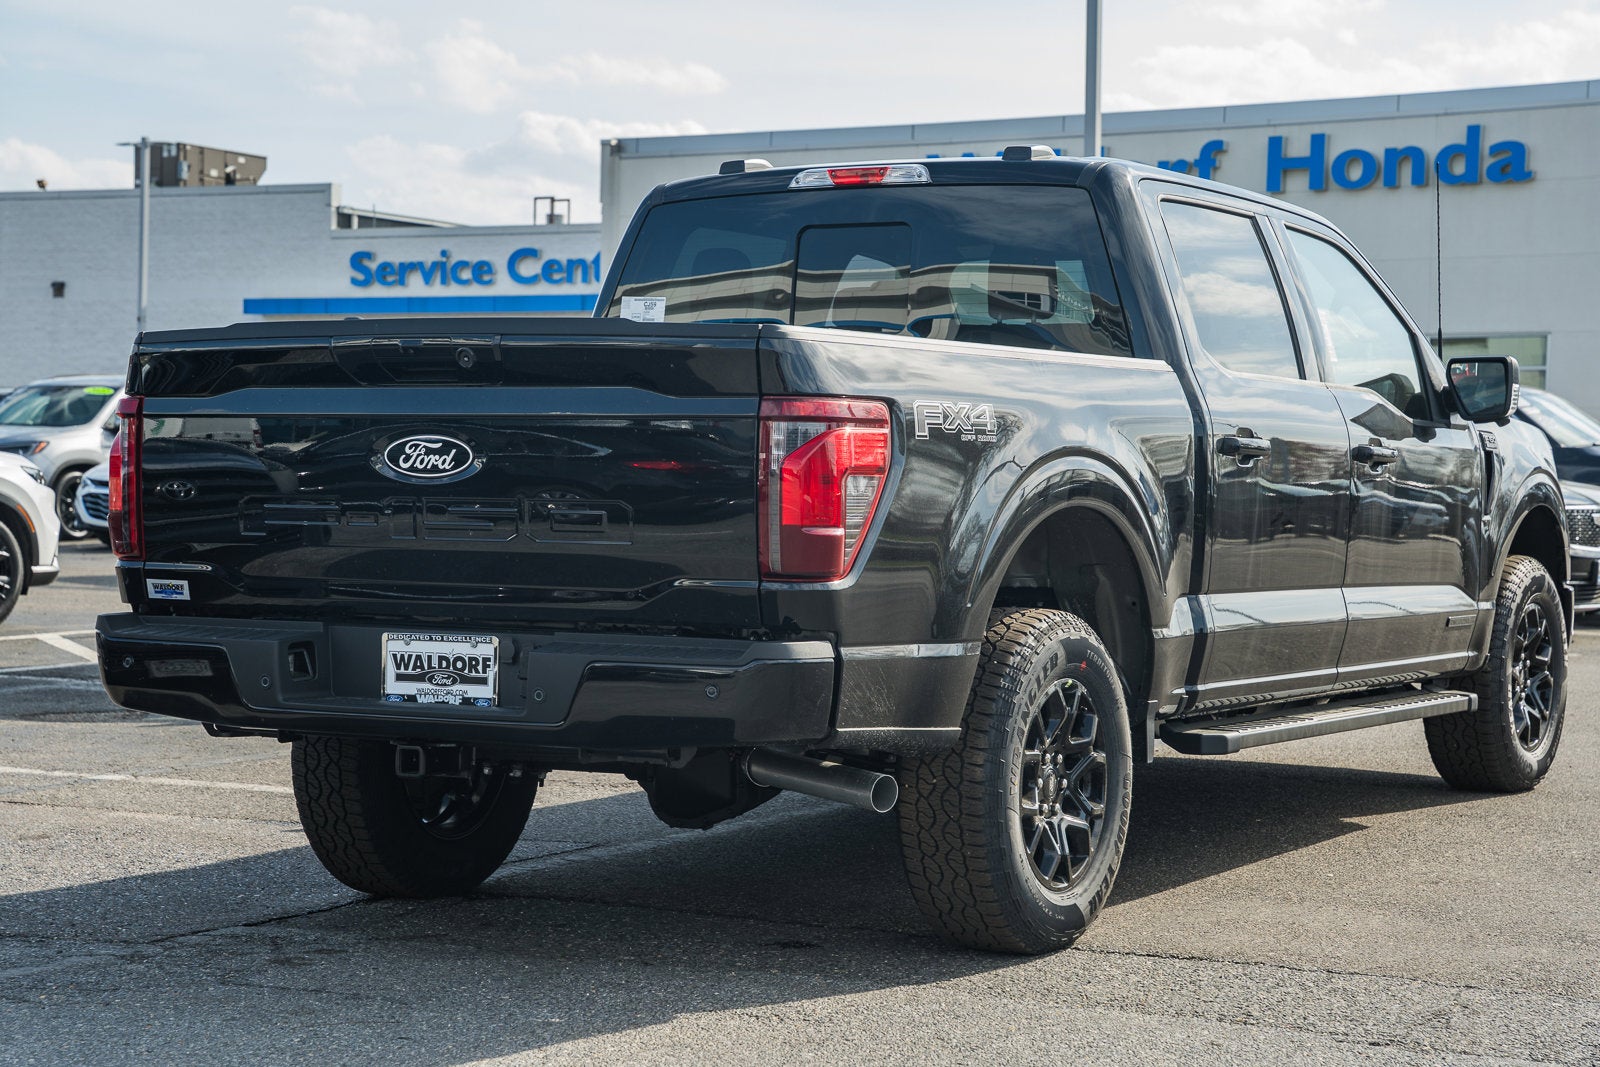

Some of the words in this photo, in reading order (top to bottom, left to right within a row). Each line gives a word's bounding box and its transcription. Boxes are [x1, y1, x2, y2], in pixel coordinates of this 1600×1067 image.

[1266, 124, 1533, 193] Honda
[349, 249, 494, 287] Service
[913, 400, 997, 439] FX4
[398, 440, 457, 470] Ford
[391, 653, 492, 674] WALDORF
[432, 674, 453, 685] Ford
[416, 694, 462, 705] WALDORF
